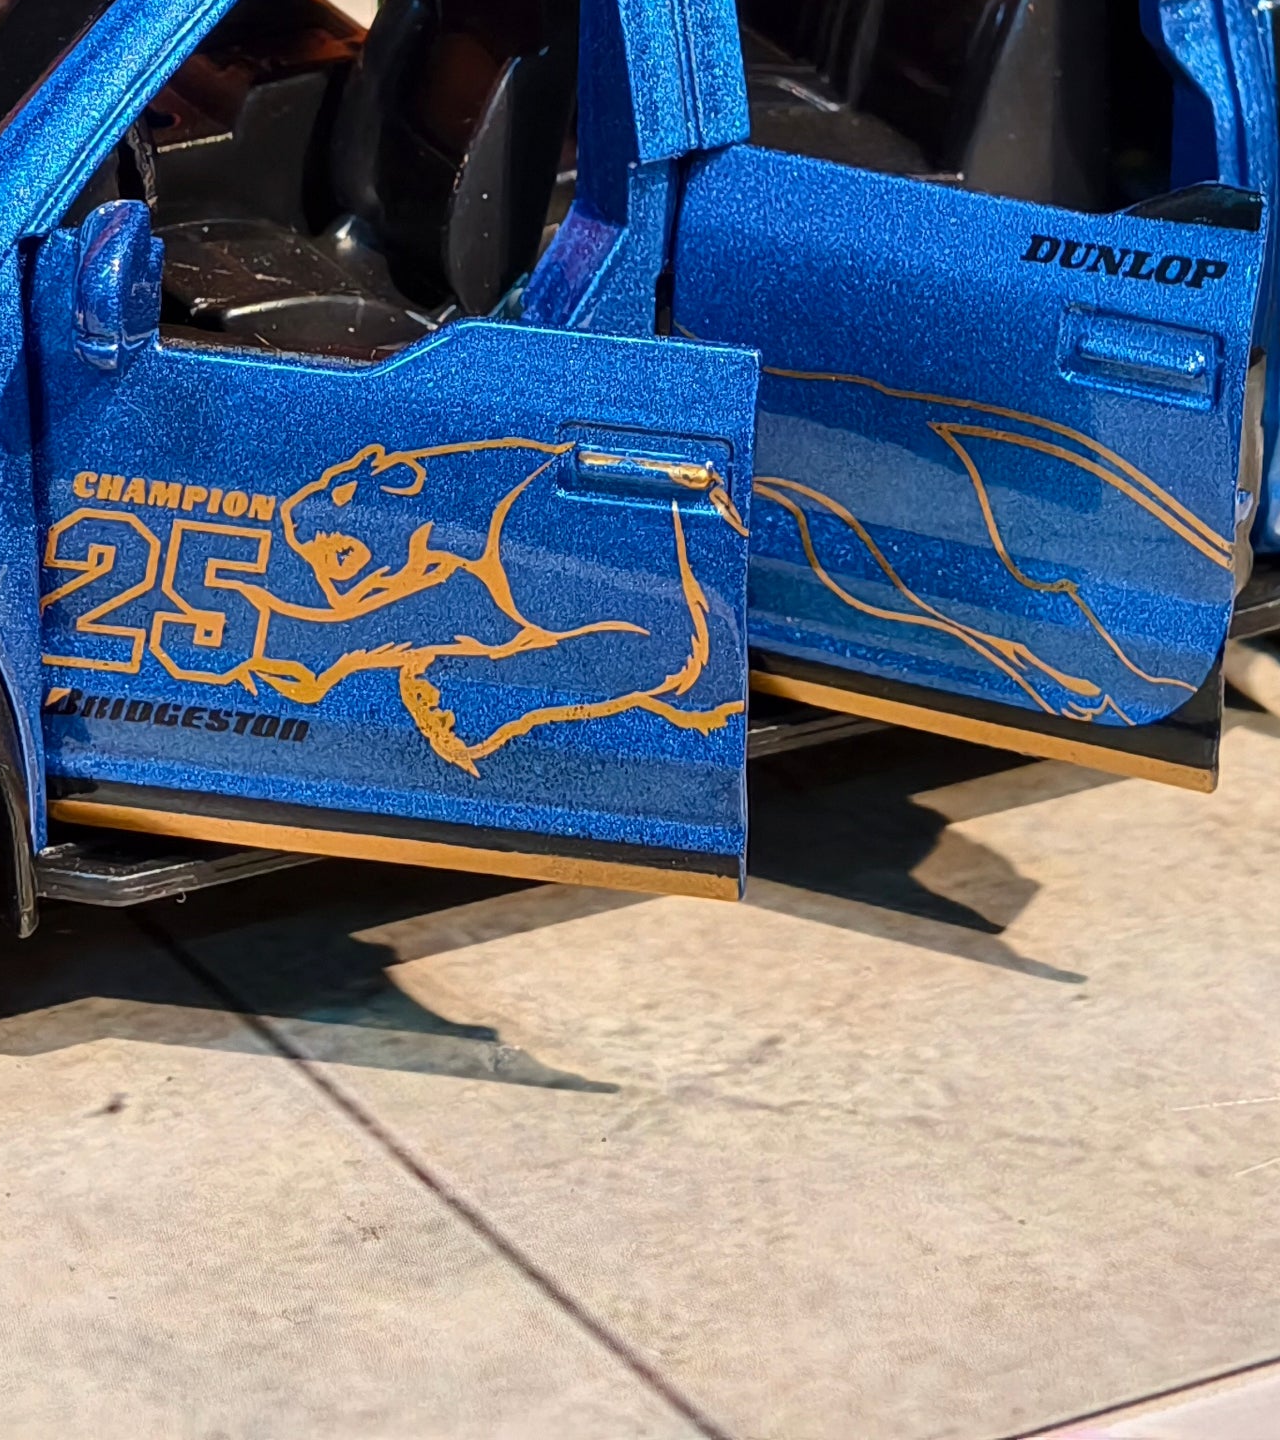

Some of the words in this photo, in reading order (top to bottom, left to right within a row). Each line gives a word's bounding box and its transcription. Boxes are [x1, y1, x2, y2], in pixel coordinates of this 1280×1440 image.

[1021, 234, 1228, 289] DUNLOP
[73, 471, 276, 521] CHAMPION
[40, 507, 272, 685] 25
